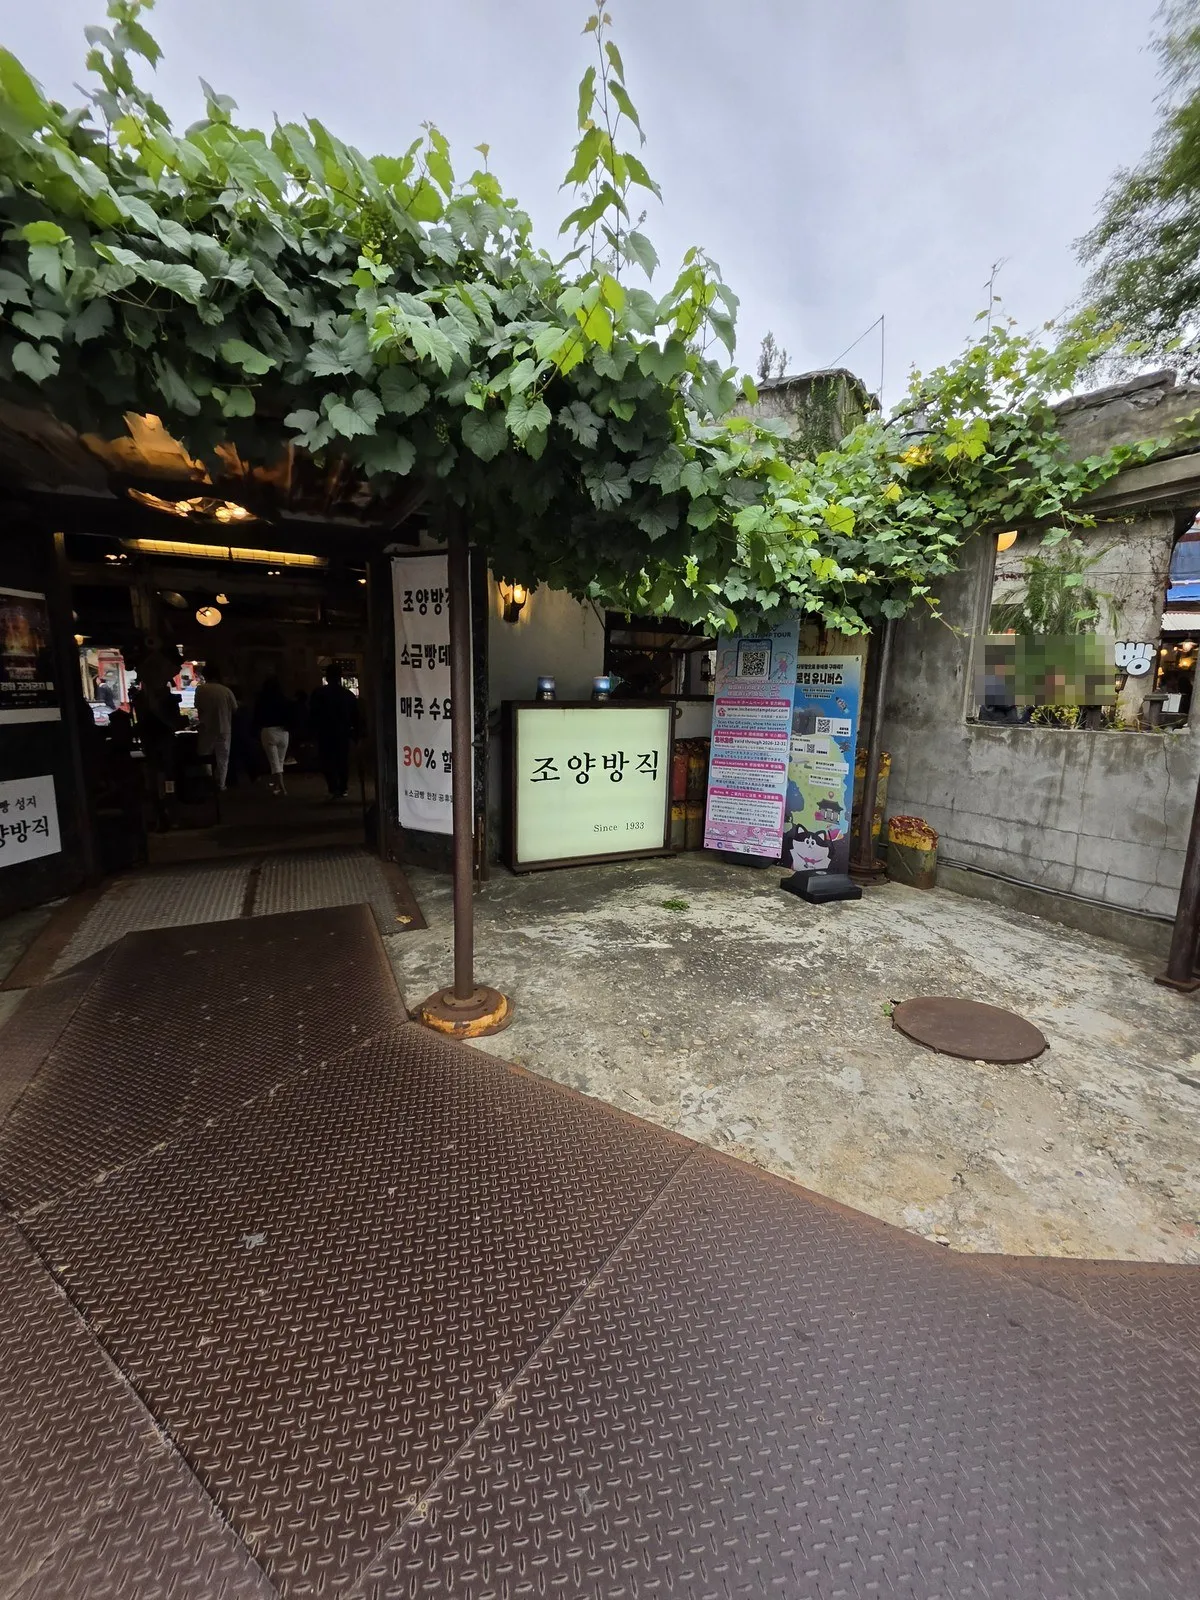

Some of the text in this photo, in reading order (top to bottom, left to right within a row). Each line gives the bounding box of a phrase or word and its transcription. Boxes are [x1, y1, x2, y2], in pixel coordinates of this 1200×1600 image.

[401, 644, 451, 670] 소금빵데
[1114, 642, 1157, 676] 빵
[796, 672, 811, 684] 로컬
[812, 672, 843, 685] 유니버스
[400, 697, 453, 720] 매주 수요
[403, 746, 436, 769] 30%
[530, 750, 658, 784] 조양방직
[15, 796, 36, 811] 성지
[593, 822, 645, 833] Since 1933
